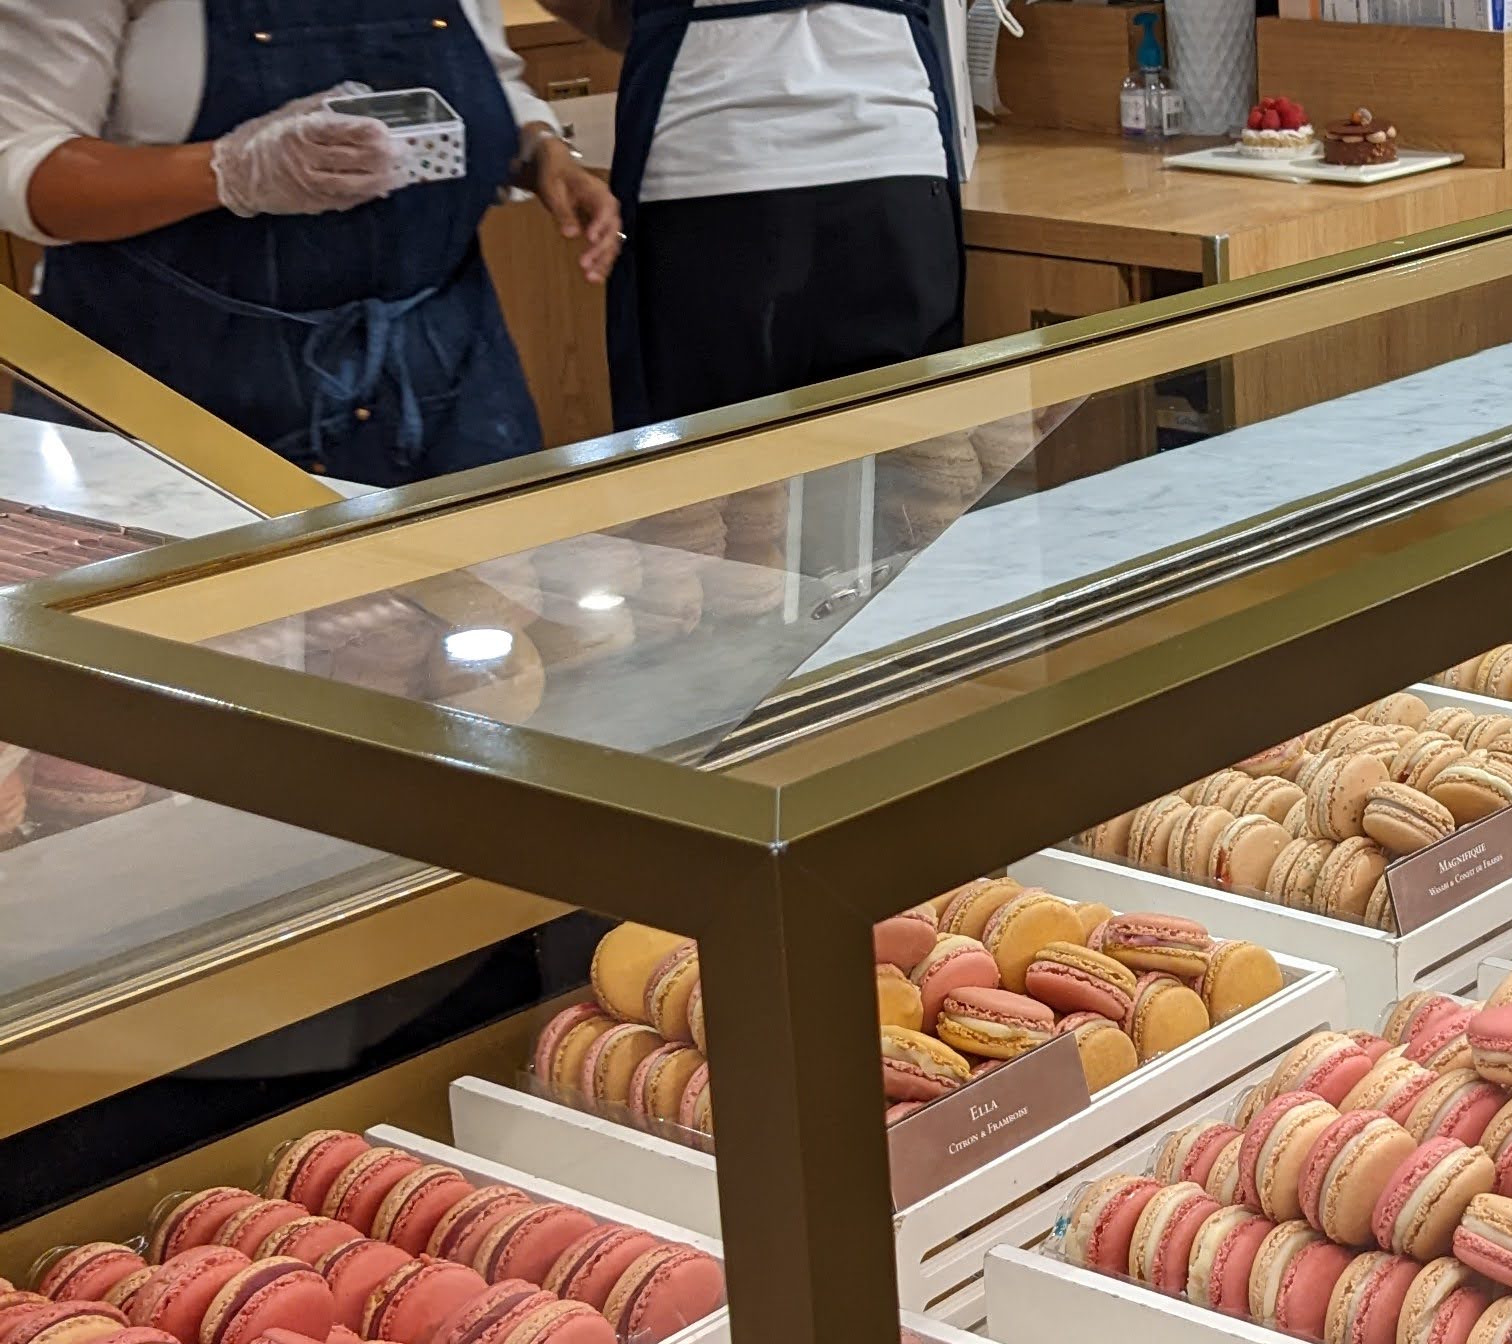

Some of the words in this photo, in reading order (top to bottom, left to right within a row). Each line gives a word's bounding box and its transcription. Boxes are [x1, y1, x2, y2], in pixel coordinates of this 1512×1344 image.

[1438, 842, 1487, 874] MAGNIFIQUE
[969, 1099, 998, 1121] ELLA
[948, 1133, 979, 1155] CITRON
[980, 1130, 987, 1138] &
[987, 1106, 1029, 1134] FRAMBOISE
